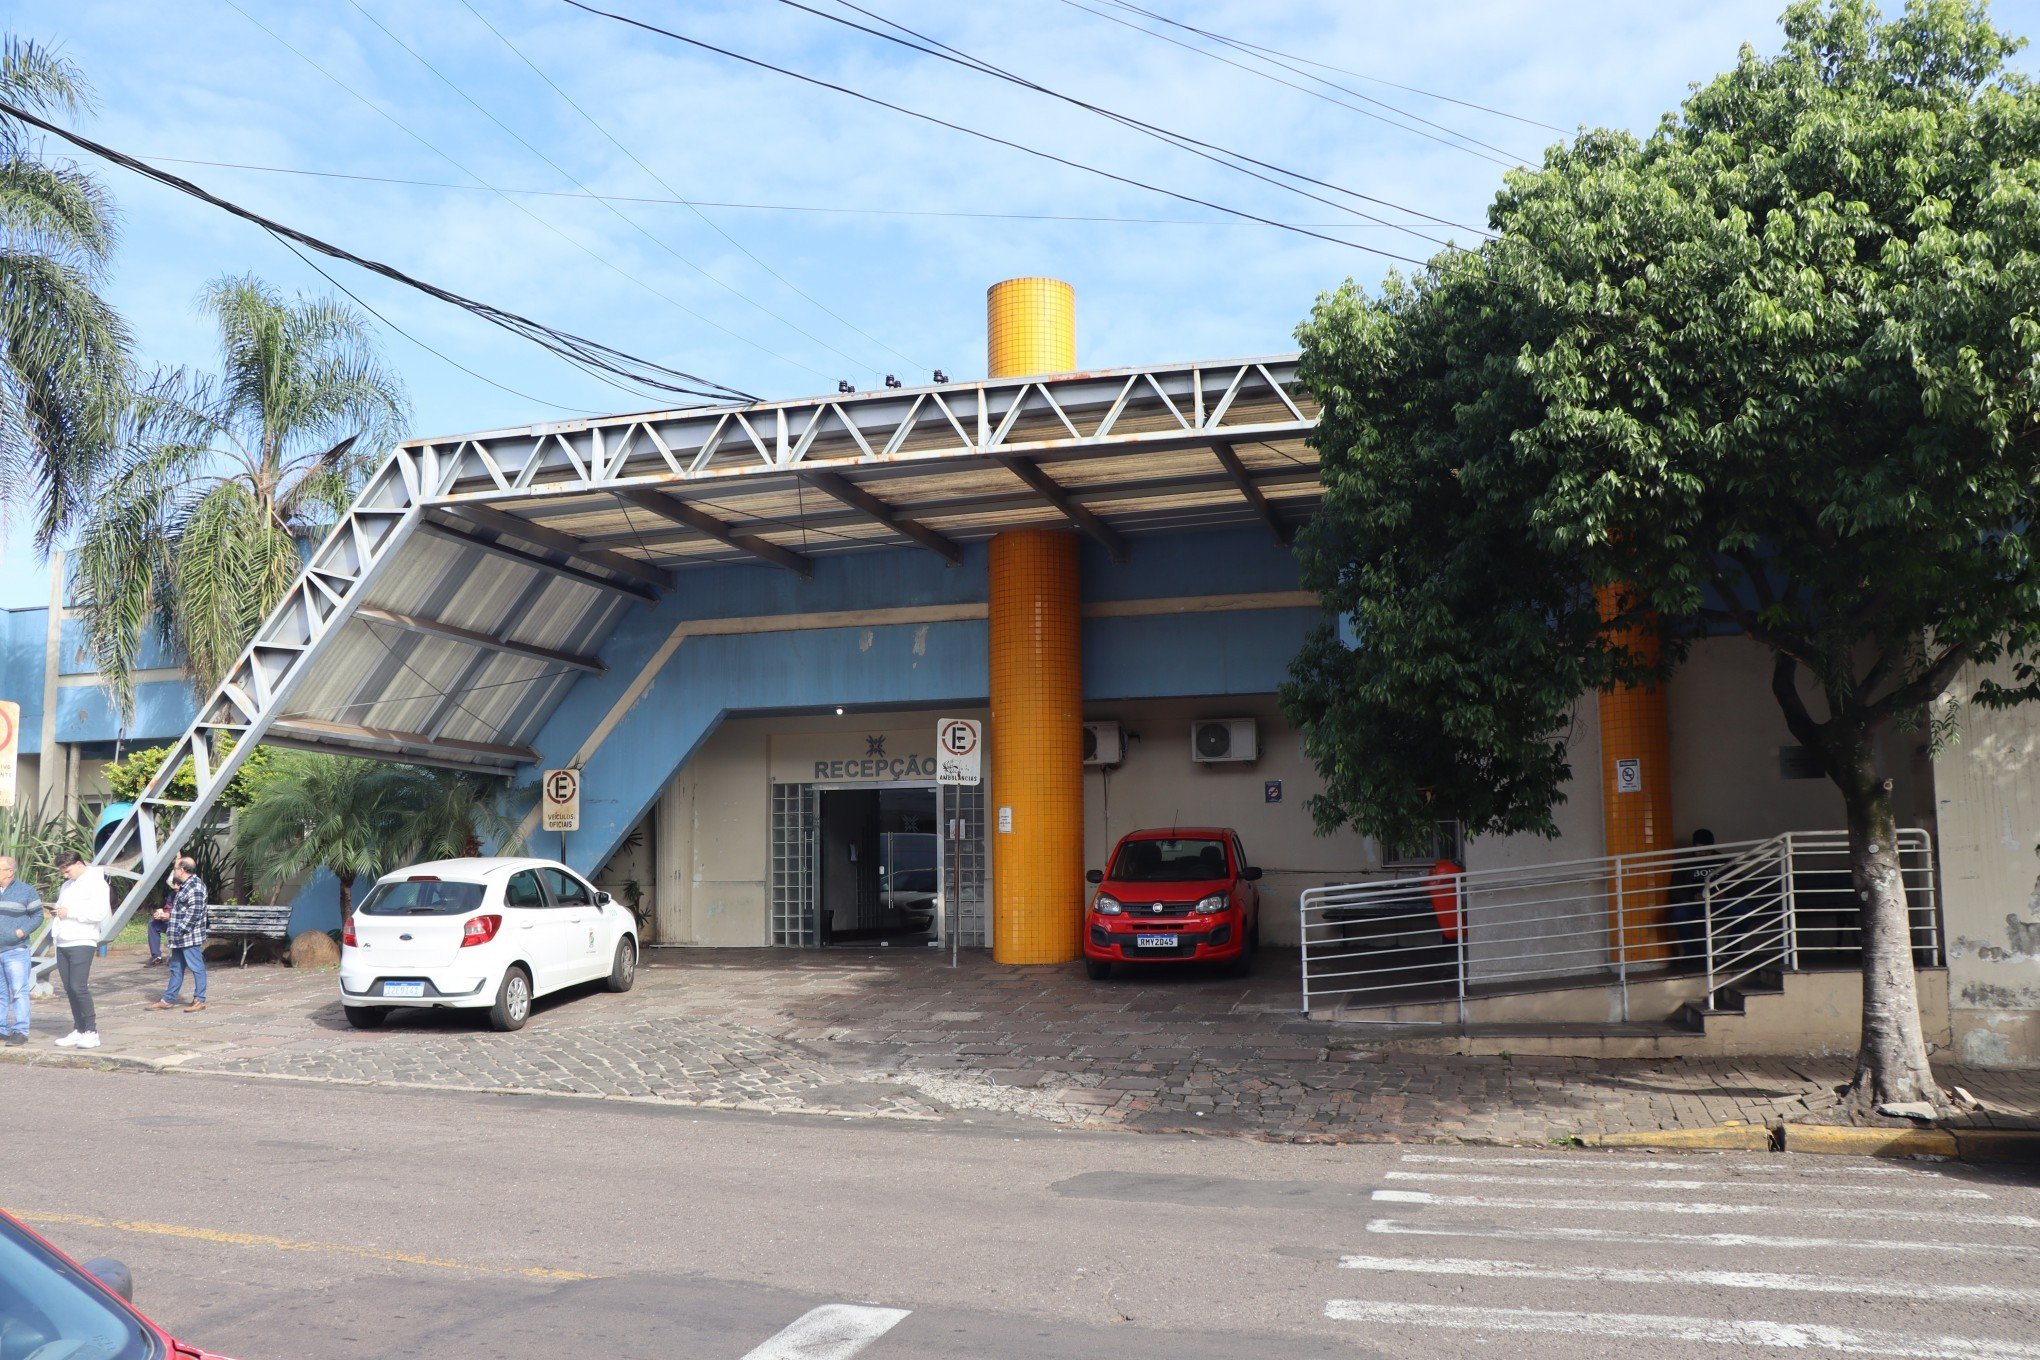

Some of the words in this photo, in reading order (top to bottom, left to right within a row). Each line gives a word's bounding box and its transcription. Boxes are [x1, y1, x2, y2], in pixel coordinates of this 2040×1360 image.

[951, 726, 966, 750] E
[814, 754, 937, 781] RECEPÇÃO
[555, 776, 567, 799] E
